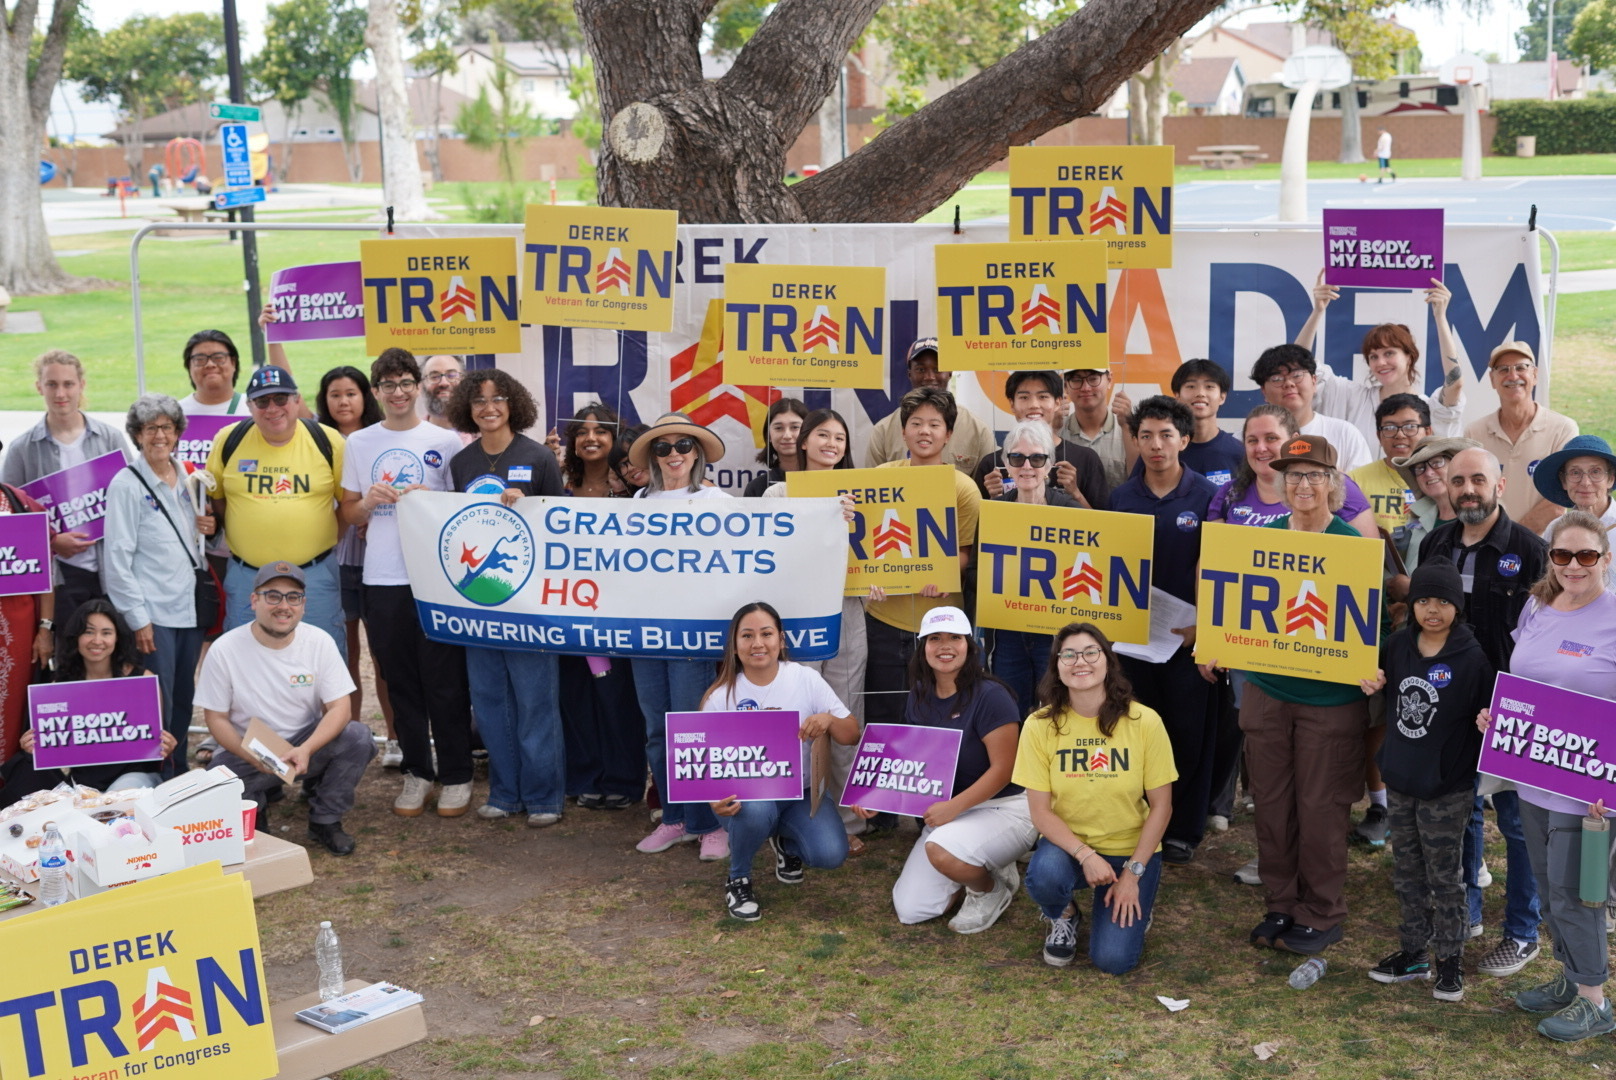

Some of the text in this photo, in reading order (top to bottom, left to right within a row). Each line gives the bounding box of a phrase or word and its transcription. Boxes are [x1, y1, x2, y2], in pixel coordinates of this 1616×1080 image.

[1057, 165, 1123, 181] DEREK
[1011, 186, 1171, 235] TRAN
[569, 225, 629, 242] DEREK
[1107, 239, 1146, 250] ngress
[1329, 239, 1411, 254] MY BODY.
[408, 256, 470, 271] DEREK
[526, 243, 672, 299] TRAN
[987, 262, 1055, 279] DEREK
[1329, 254, 1434, 269] MY BALLOT.
[273, 292, 347, 309] MY BODY.
[364, 275, 519, 324] TRAN
[773, 283, 837, 299] DEREK
[272, 304, 365, 323] MY BALLOT
[545, 296, 648, 311] Veteran for Congress
[938, 283, 1107, 336] TRAN
[390, 326, 496, 336] Veteran for Congress
[726, 303, 883, 355] TRAN
[965, 338, 1082, 350] Veteran for Congress
[749, 355, 858, 368] Veteran for Congress
[244, 473, 310, 494] TRAN
[482, 518, 496, 526] HQ
[545, 506, 795, 538] GRASSROOTS
[444, 508, 530, 566] GRASSROOTS DEMOCRATS
[847, 506, 958, 560] RAN
[1030, 525, 1100, 548] DEREK
[0, 559, 41, 575] LOT.
[545, 542, 777, 575] DEMOCRATS
[864, 564, 880, 573] for
[883, 563, 934, 574] Congress
[1253, 549, 1326, 575] DEREK
[980, 543, 1151, 610] TRAN
[541, 578, 599, 611] HQ
[1004, 600, 1123, 621] Veteran for Congress
[1201, 568, 1380, 647] TRAN
[430, 610, 829, 651] POWERING THE BLUE VE
[1224, 633, 1349, 658] Veteran for Congress
[1429, 672, 1452, 680] TRAN
[38, 711, 127, 732] MY BODY.
[39, 724, 153, 747] MY BALLOT.
[1076, 738, 1107, 746] DEREK
[1491, 731, 1528, 755] MY
[1495, 713, 1597, 756] MY BODY.
[674, 746, 767, 763] MY BODY.
[1056, 747, 1129, 772] TRAN
[675, 761, 792, 779] MY BALLOT.
[856, 756, 925, 777] MY BODY.
[851, 770, 943, 796] MY BALLOT.
[173, 819, 224, 834] UNKIN'
[69, 930, 177, 975] DEREK
[0, 948, 265, 1078] TRAN
[124, 1061, 149, 1077] for
[154, 1042, 231, 1070] Congress
